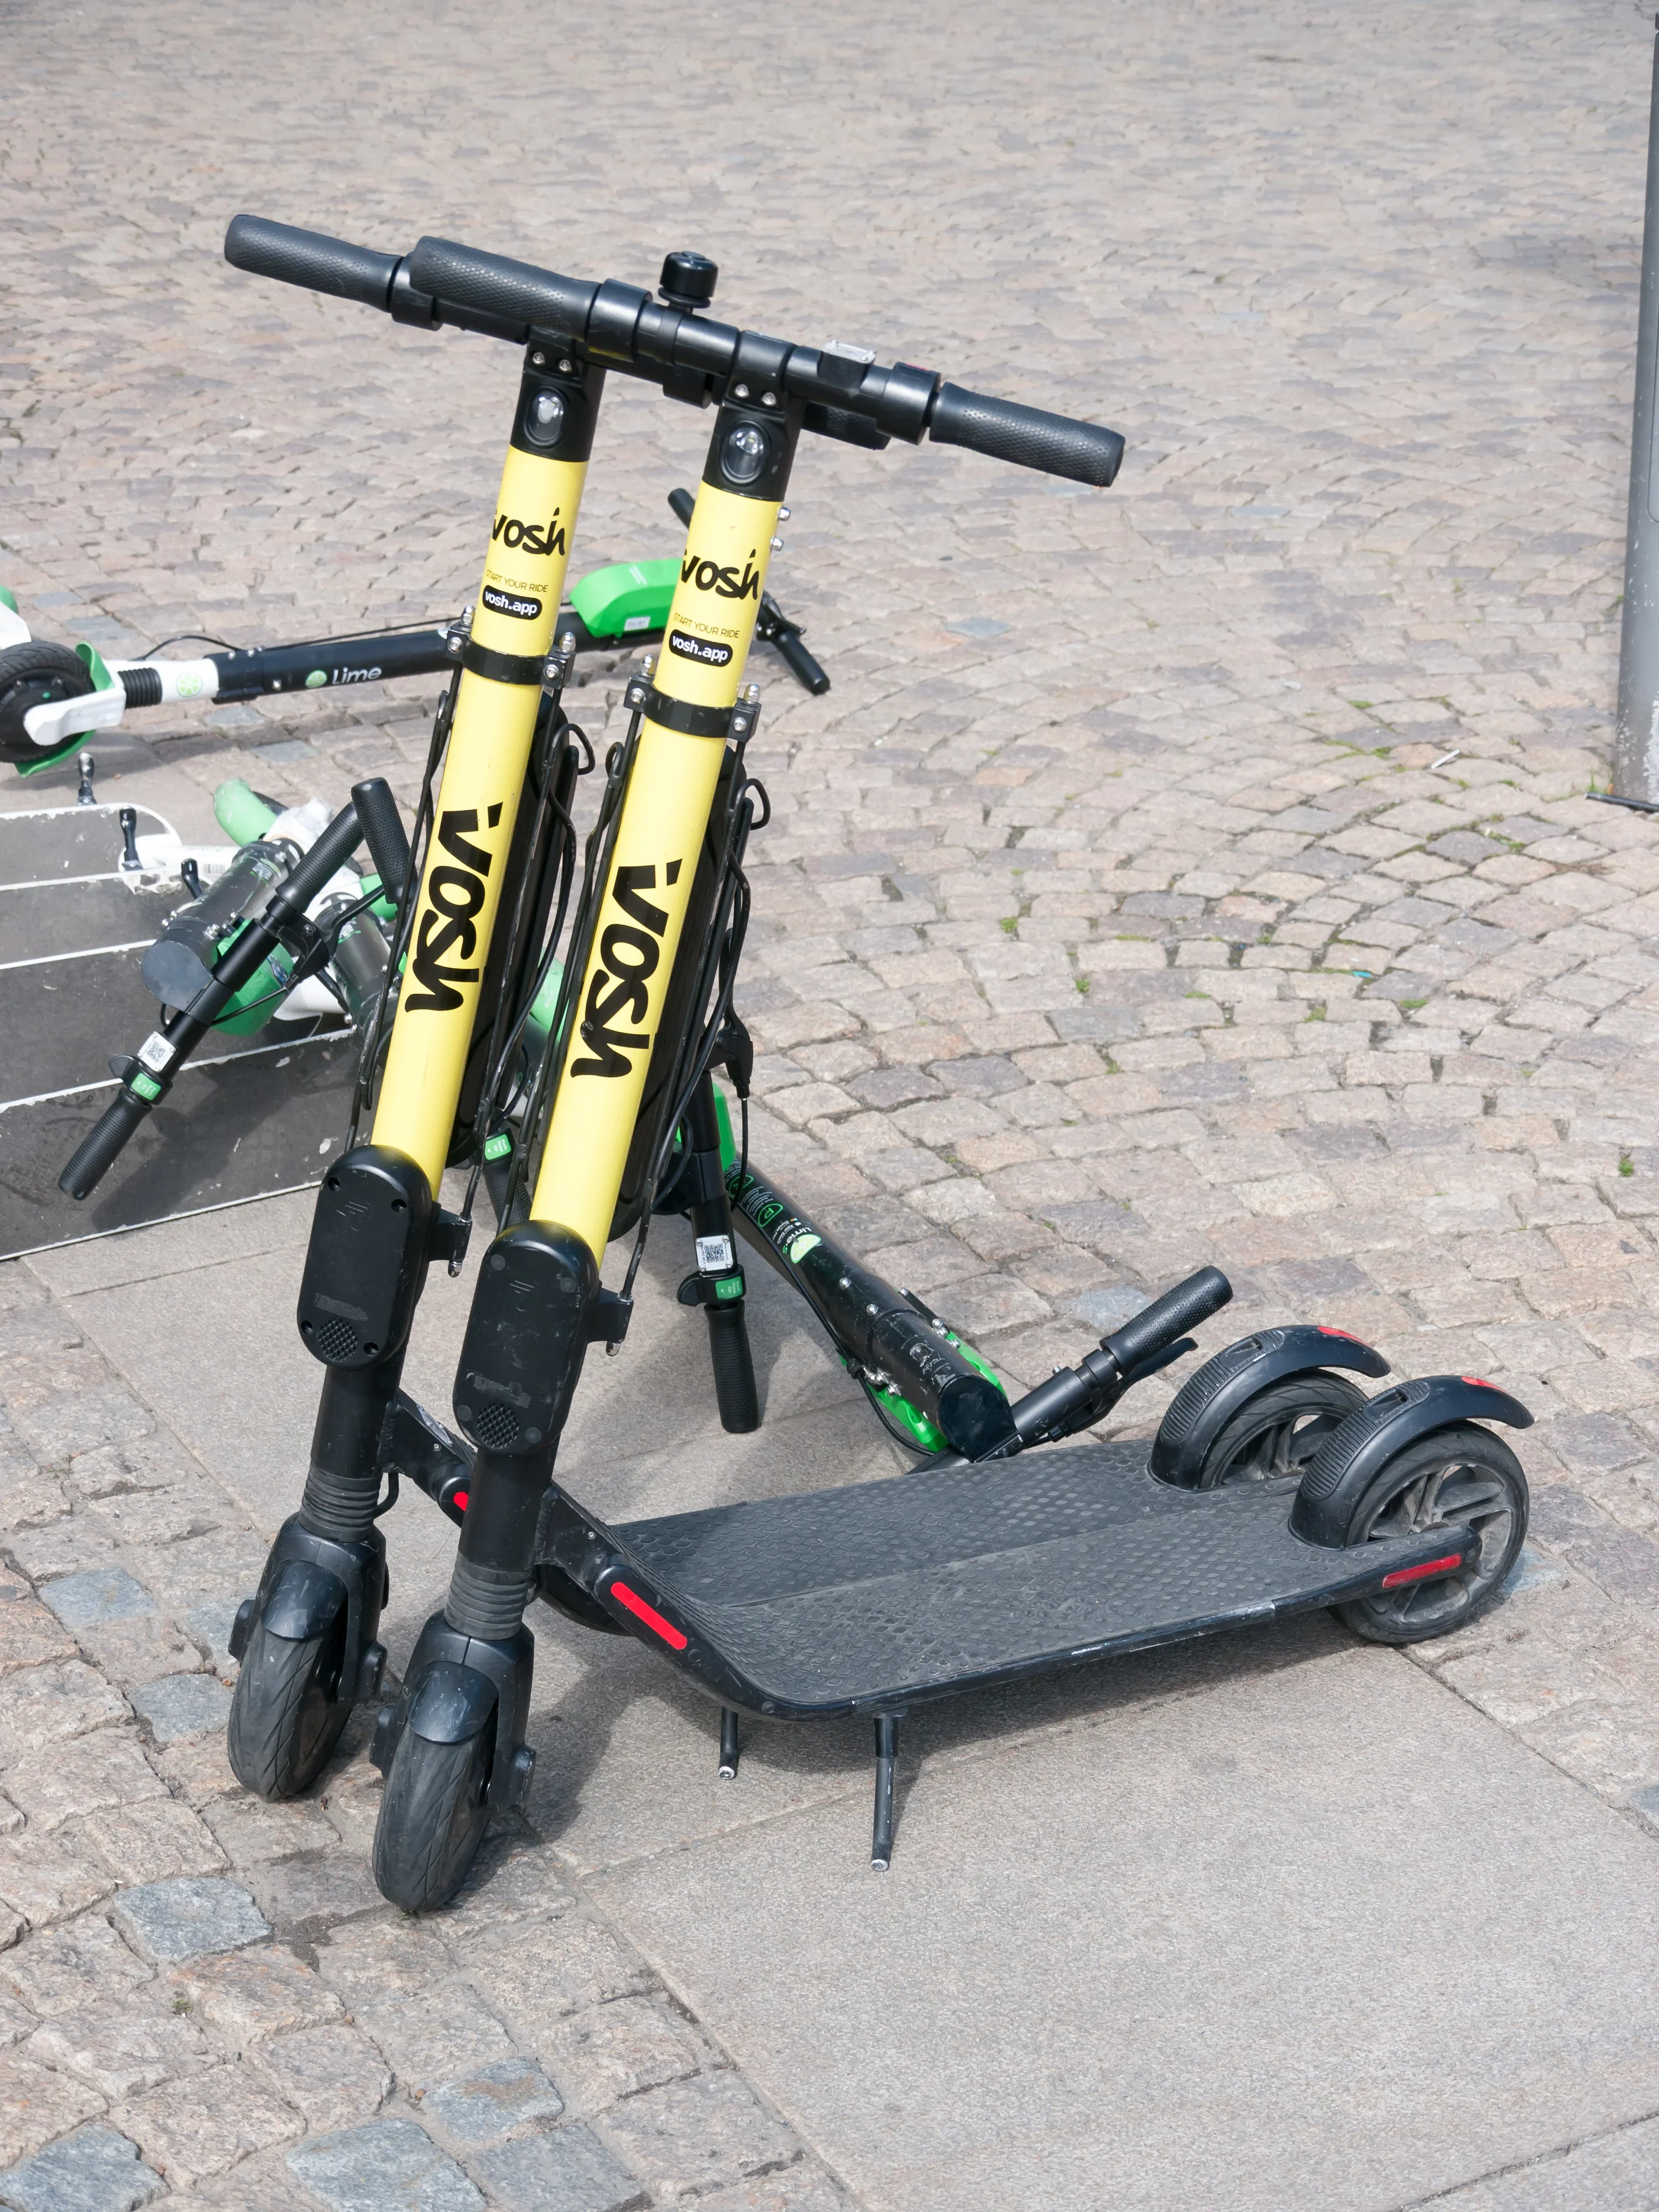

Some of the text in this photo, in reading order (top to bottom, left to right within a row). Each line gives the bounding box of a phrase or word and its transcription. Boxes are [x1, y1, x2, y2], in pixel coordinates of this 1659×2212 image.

[486, 569, 549, 592] START YOUR RIDE
[485, 591, 538, 616] vosh.app
[673, 612, 740, 638] START YOUR RIDE
[672, 635, 728, 662] vosh.app
[332, 666, 382, 685] Lime
